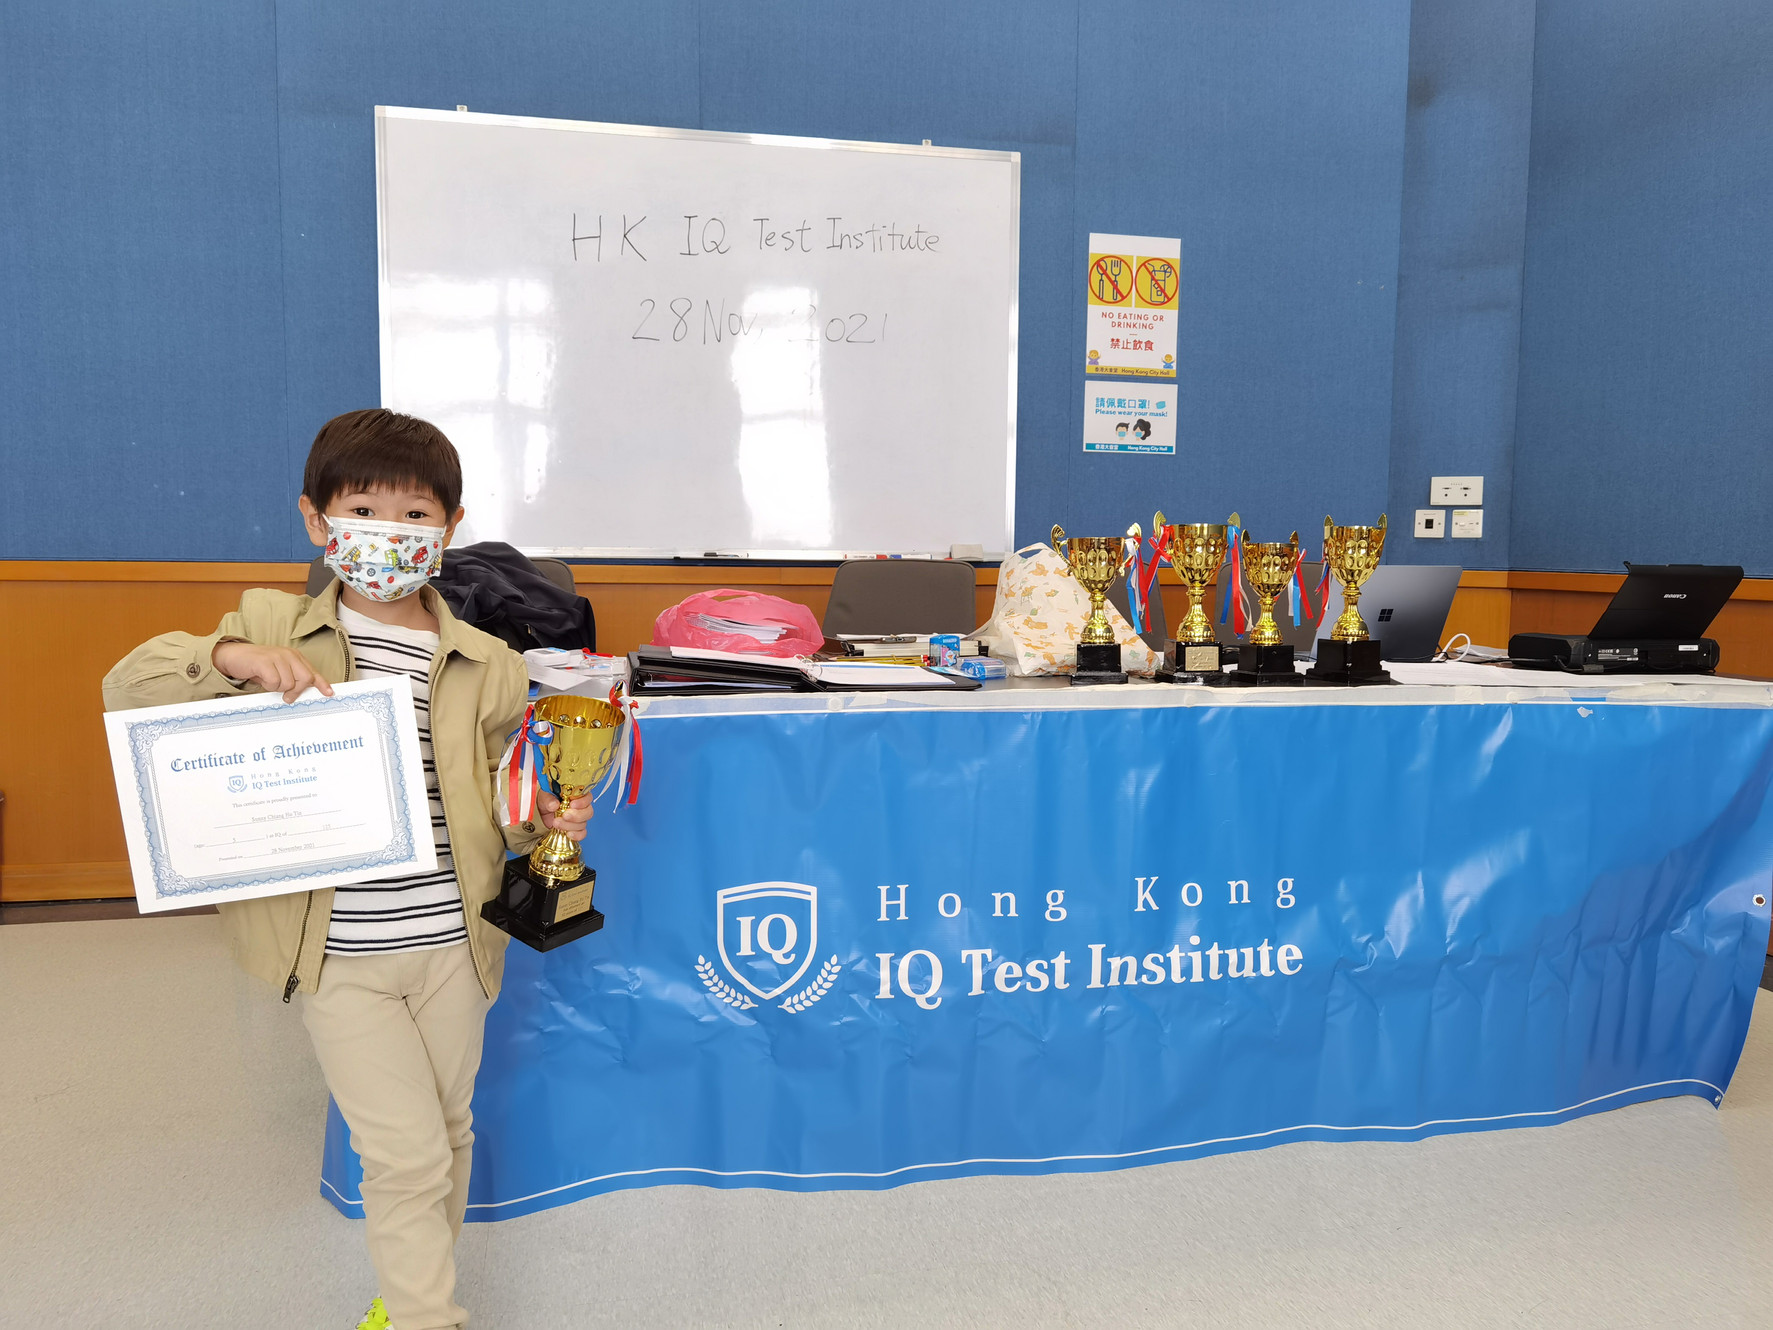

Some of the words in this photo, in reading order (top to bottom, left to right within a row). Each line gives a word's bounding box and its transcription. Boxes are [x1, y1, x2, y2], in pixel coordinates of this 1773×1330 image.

[680, 215, 730, 255] IQ
[753, 218, 812, 252] Test
[826, 217, 942, 253] Institute
[632, 298, 692, 342] 28
[788, 304, 888, 343] 2021
[1111, 322, 1154, 330] DRINKING
[1110, 338, 1154, 351] 禁止飲食
[170, 752, 246, 772] Certificate
[253, 747, 266, 761] of
[272, 735, 364, 759] Achievement
[251, 771, 279, 779] Hong
[288, 766, 316, 775] Kong
[252, 782, 263, 790] IQ
[264, 779, 281, 788] Test
[283, 775, 318, 786] Institute
[876, 884, 1068, 922] Hong
[1134, 876, 1296, 912] Kong
[736, 914, 798, 965] IQ
[875, 950, 943, 1010] IQ
[961, 948, 1070, 998] Test
[1086, 935, 1304, 990] Institute
